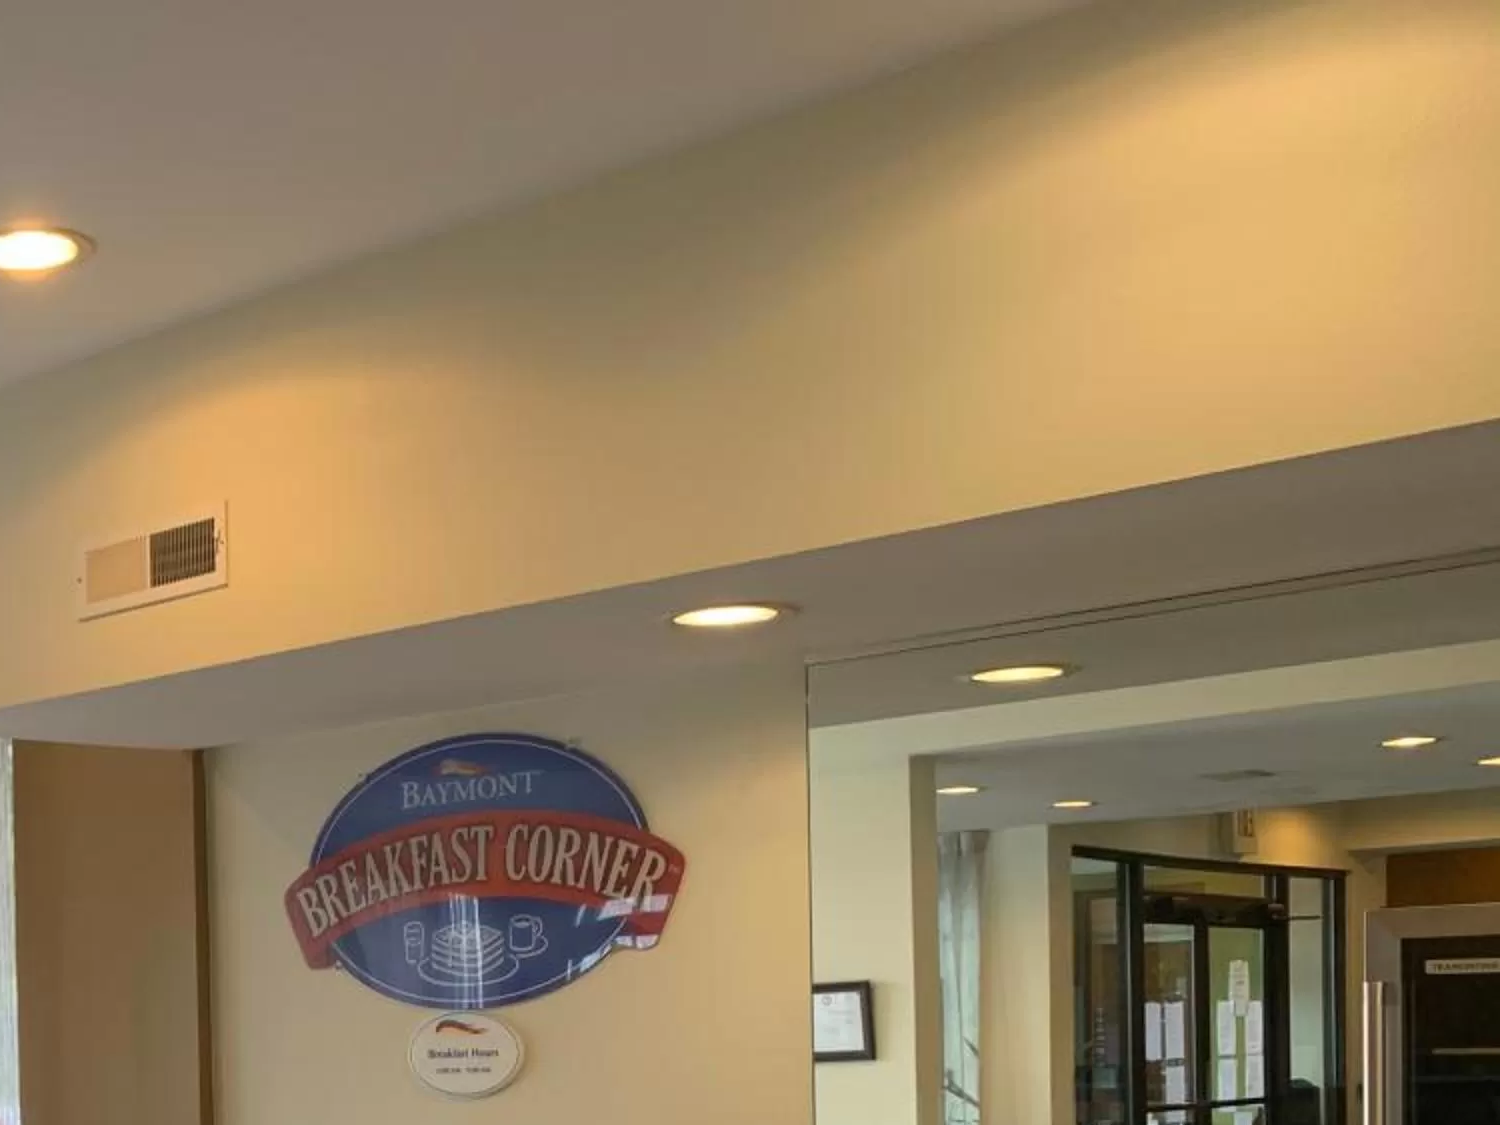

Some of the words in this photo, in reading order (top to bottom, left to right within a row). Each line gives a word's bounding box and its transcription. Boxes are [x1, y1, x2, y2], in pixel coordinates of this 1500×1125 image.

[401, 771, 535, 810] BAYMONT
[297, 825, 495, 938] BREAKFAST
[505, 824, 667, 910] CORNER
